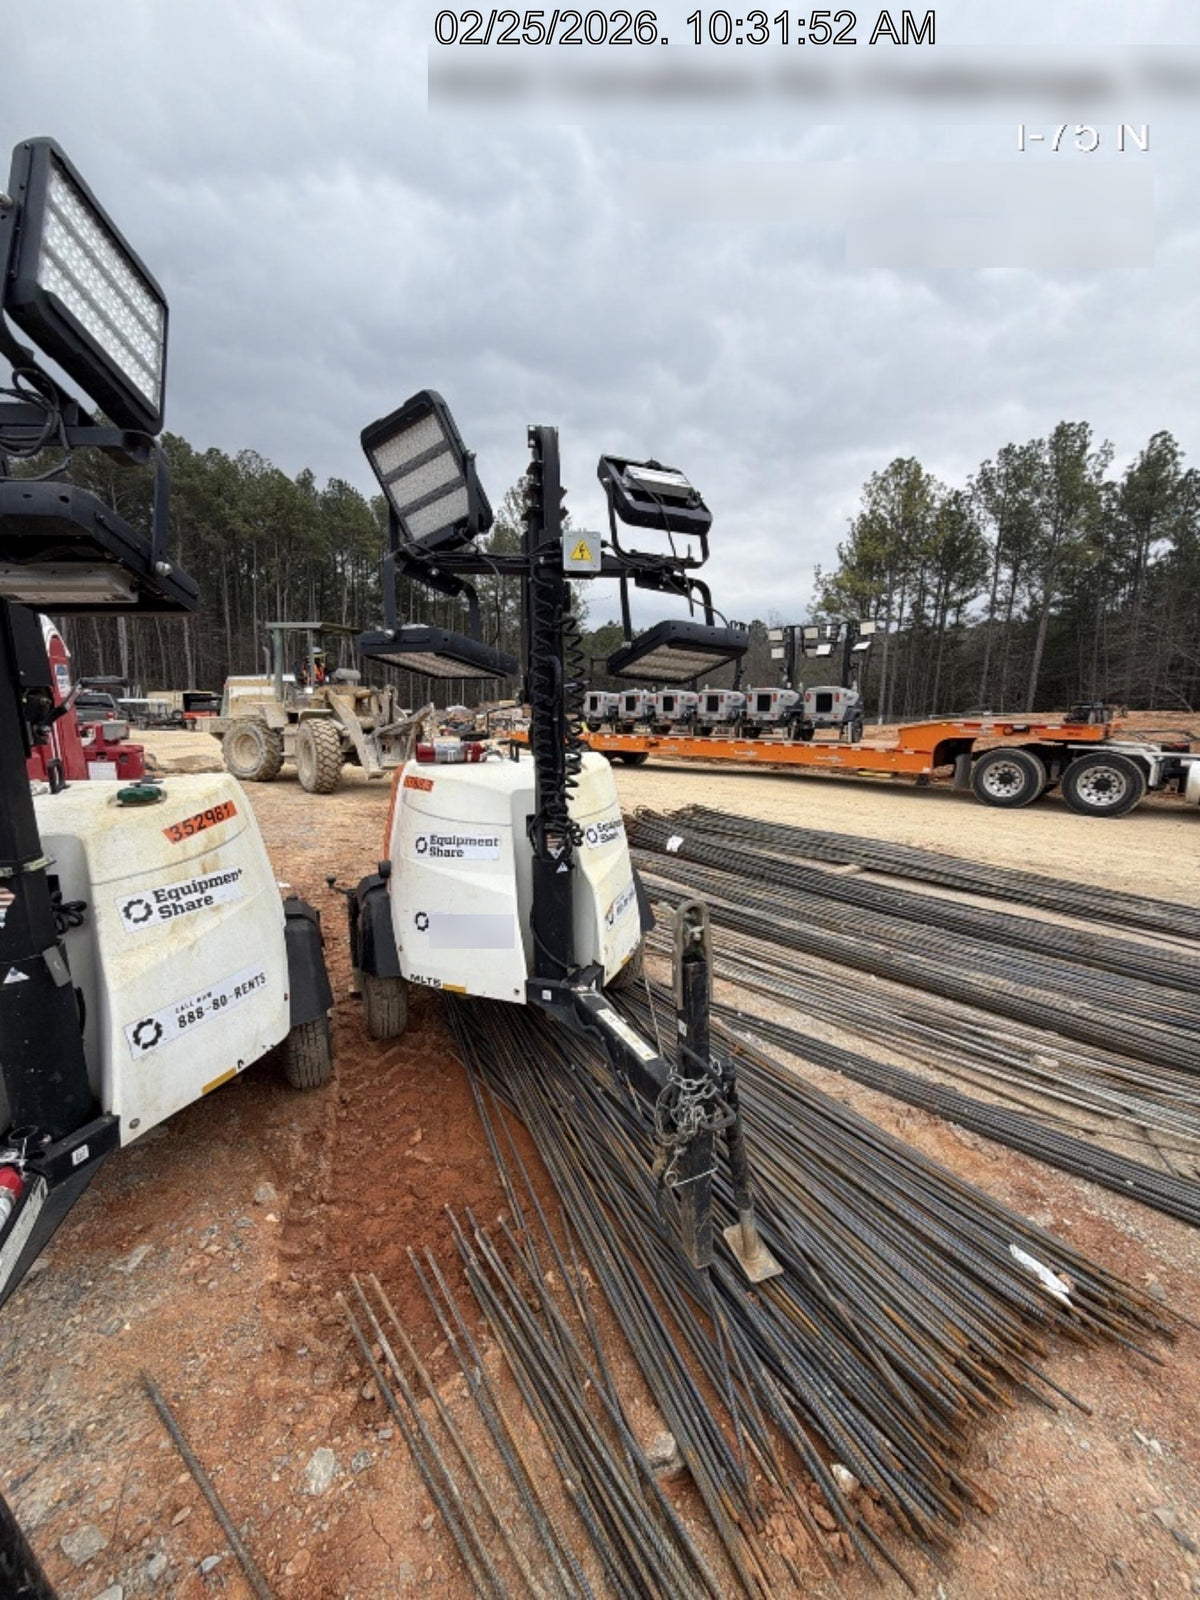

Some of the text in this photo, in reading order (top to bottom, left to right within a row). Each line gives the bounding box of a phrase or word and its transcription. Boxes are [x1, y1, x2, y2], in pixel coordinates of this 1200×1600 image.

[429, 835, 500, 848] Equipment
[429, 846, 464, 858] Share
[157, 894, 214, 919] Share
